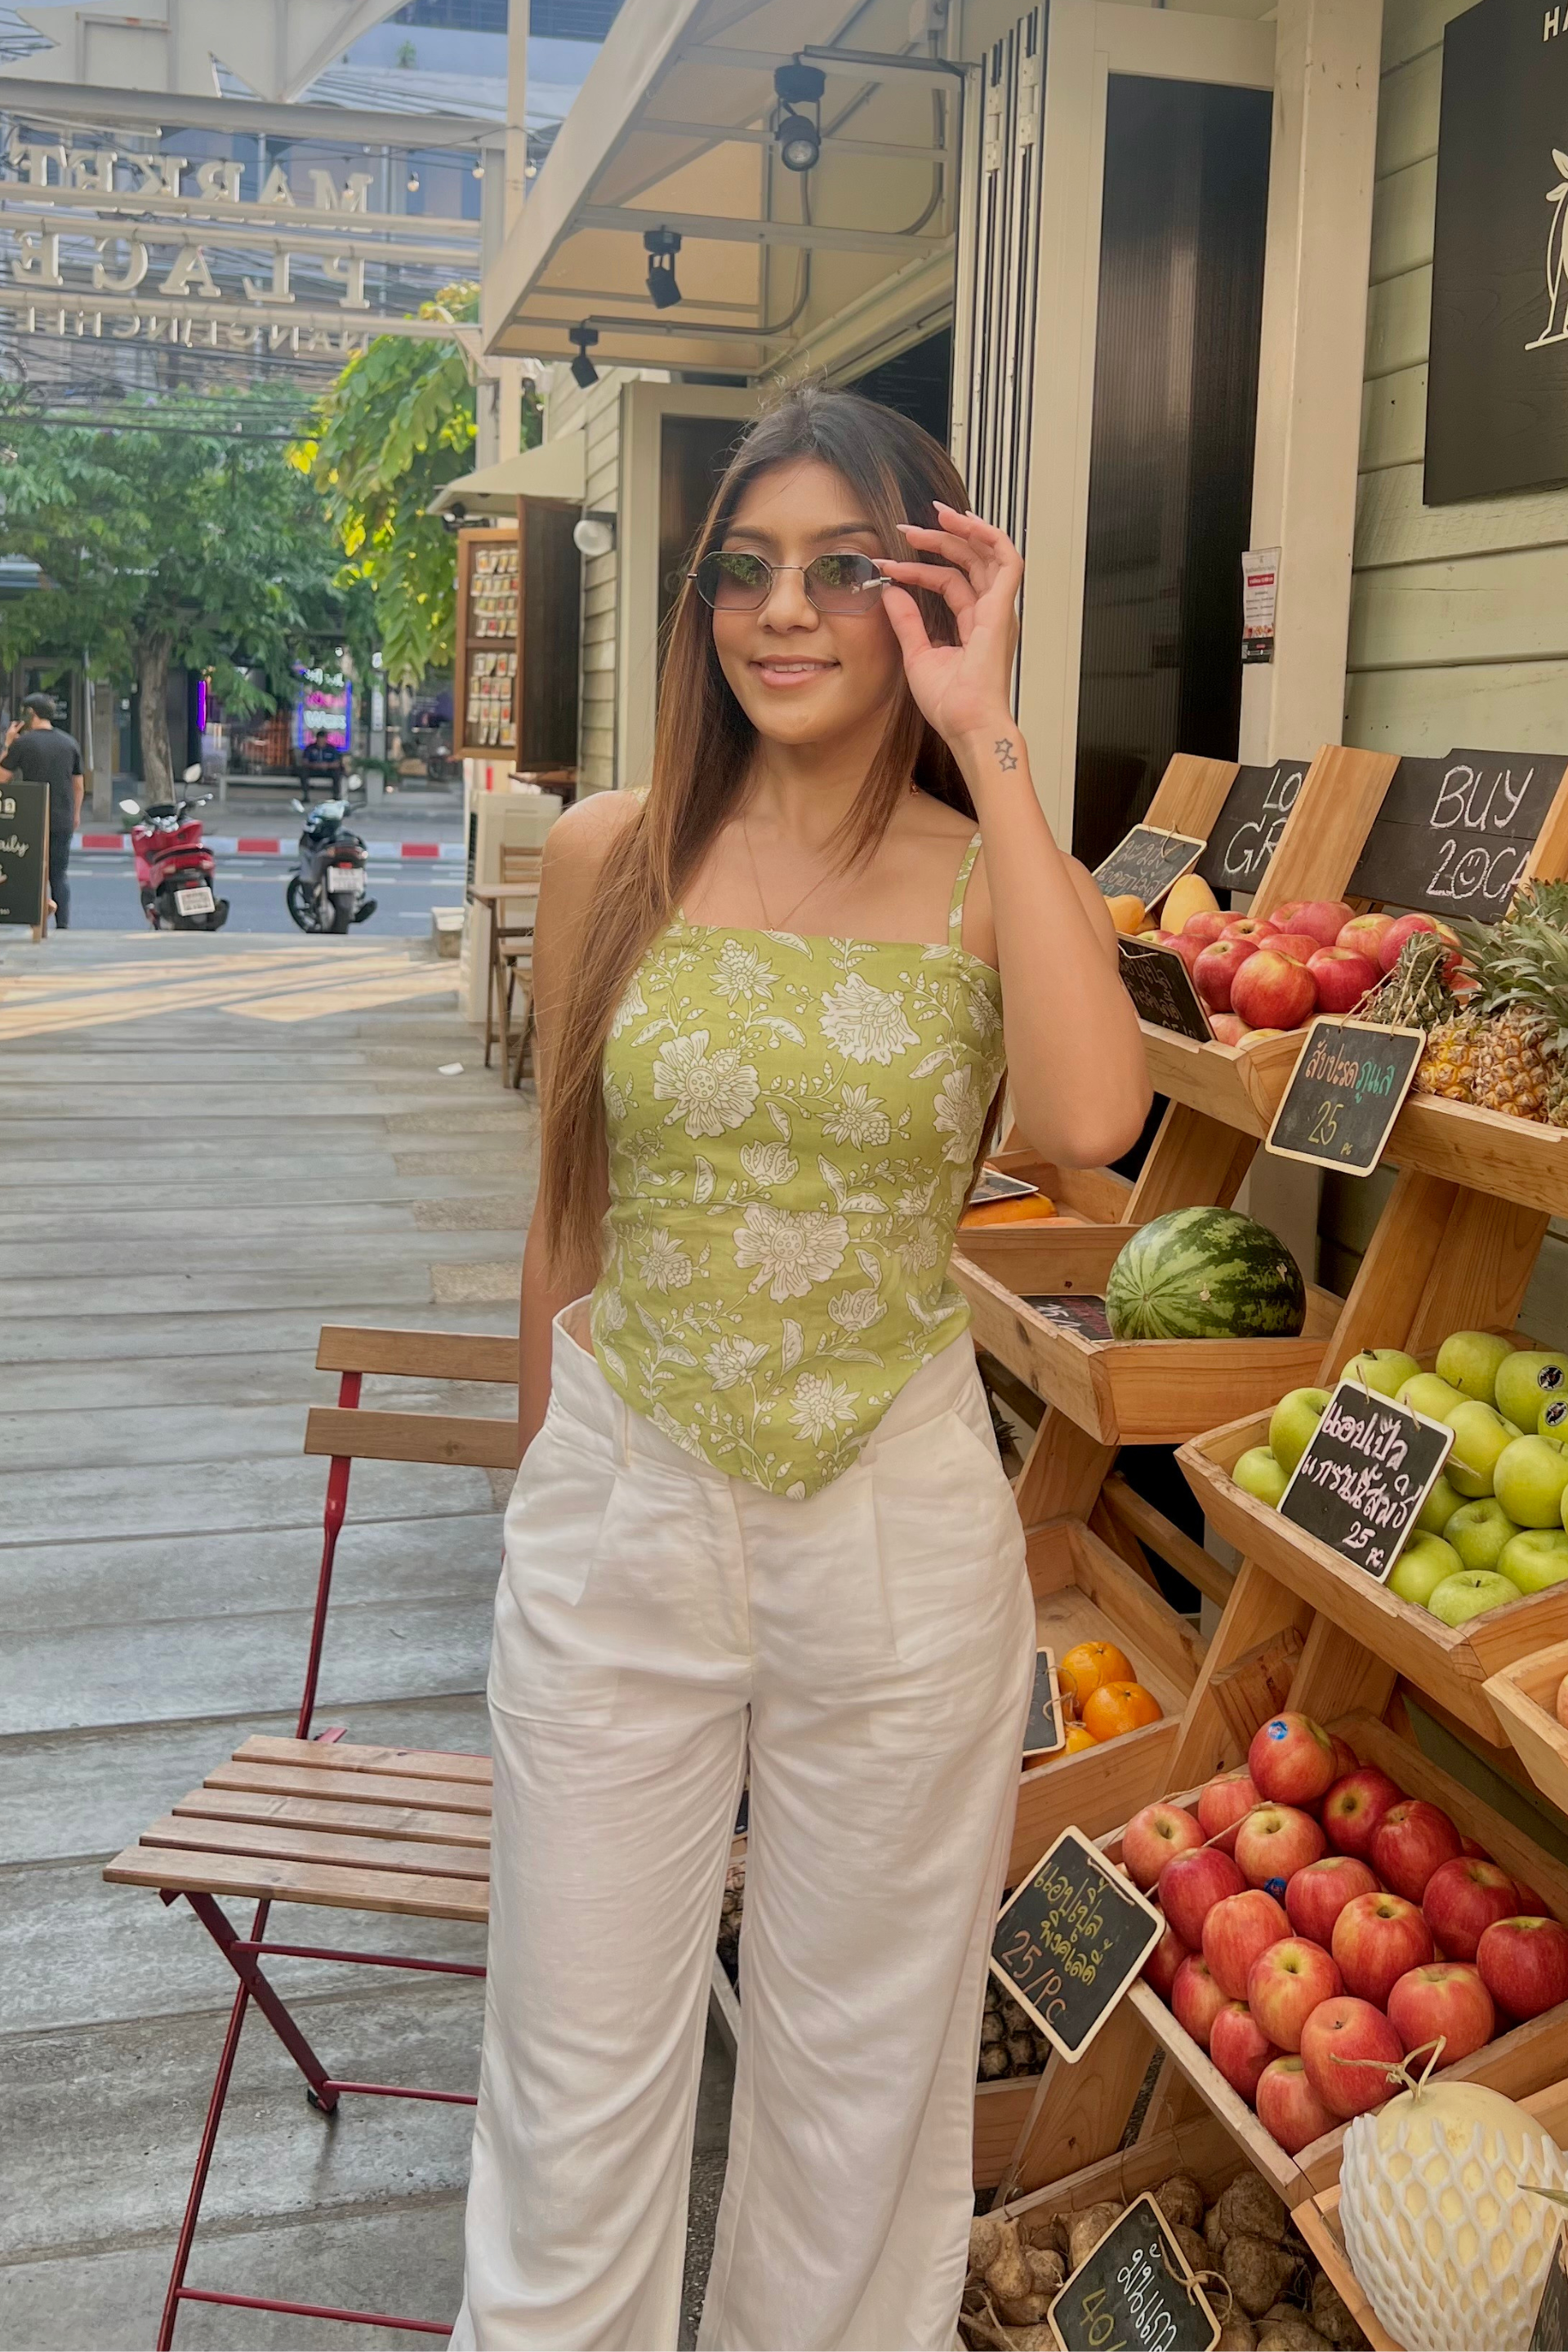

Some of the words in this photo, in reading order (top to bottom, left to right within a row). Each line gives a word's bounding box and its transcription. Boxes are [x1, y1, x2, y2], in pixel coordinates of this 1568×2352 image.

[1430, 764, 1535, 831] BUY
[1307, 1099, 1345, 1147] 25
[1342, 1520, 1377, 1549] 25
